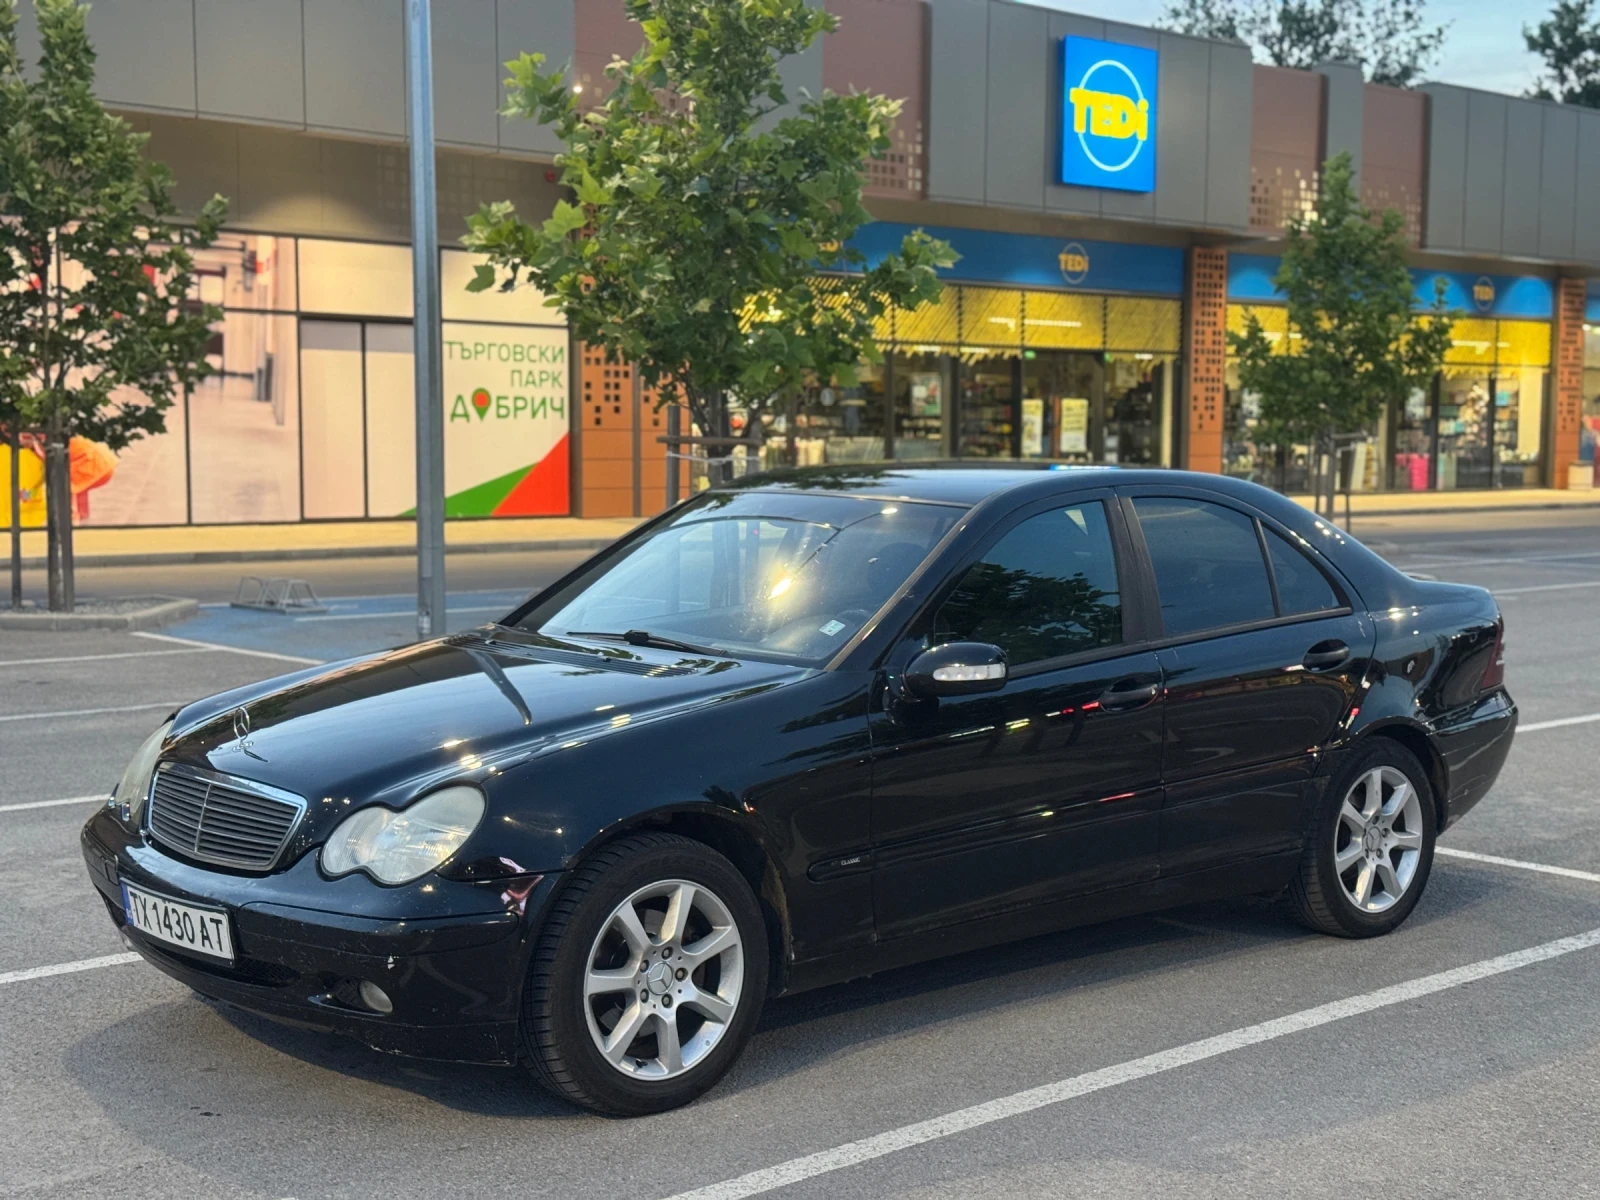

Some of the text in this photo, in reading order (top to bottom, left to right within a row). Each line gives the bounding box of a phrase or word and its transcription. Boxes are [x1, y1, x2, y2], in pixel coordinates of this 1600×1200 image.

[1069, 87, 1149, 141] TEDi
[443, 341, 565, 364] ТЪРГОВСКИ
[510, 369, 564, 388] ПАРК
[130, 890, 223, 952] TX 1430 AT
